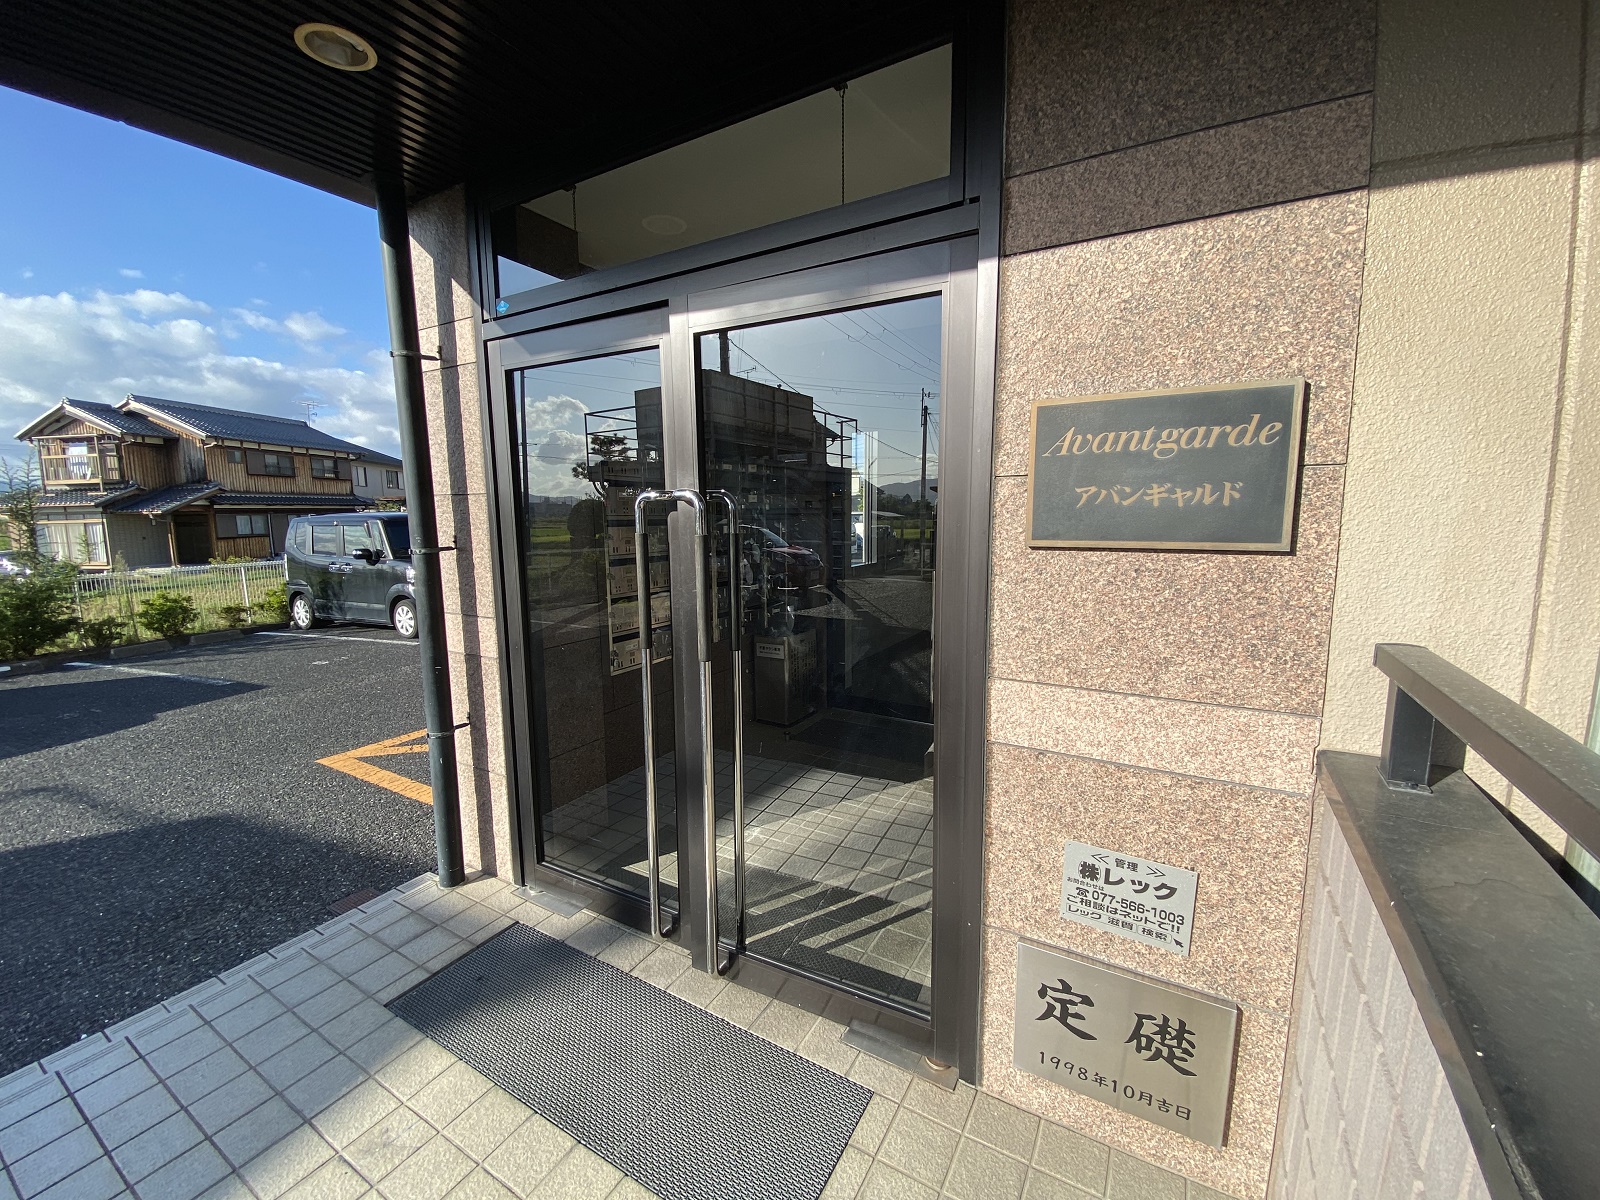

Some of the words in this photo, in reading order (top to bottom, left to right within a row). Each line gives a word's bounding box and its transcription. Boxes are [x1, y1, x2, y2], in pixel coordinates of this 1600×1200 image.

[1042, 414, 1283, 459] Avantgarde
[1074, 481, 1244, 508] アバンギャルド
[1092, 890, 1185, 926] 077-566-1003
[1039, 1051, 1192, 1121] 1998年10月吉日
